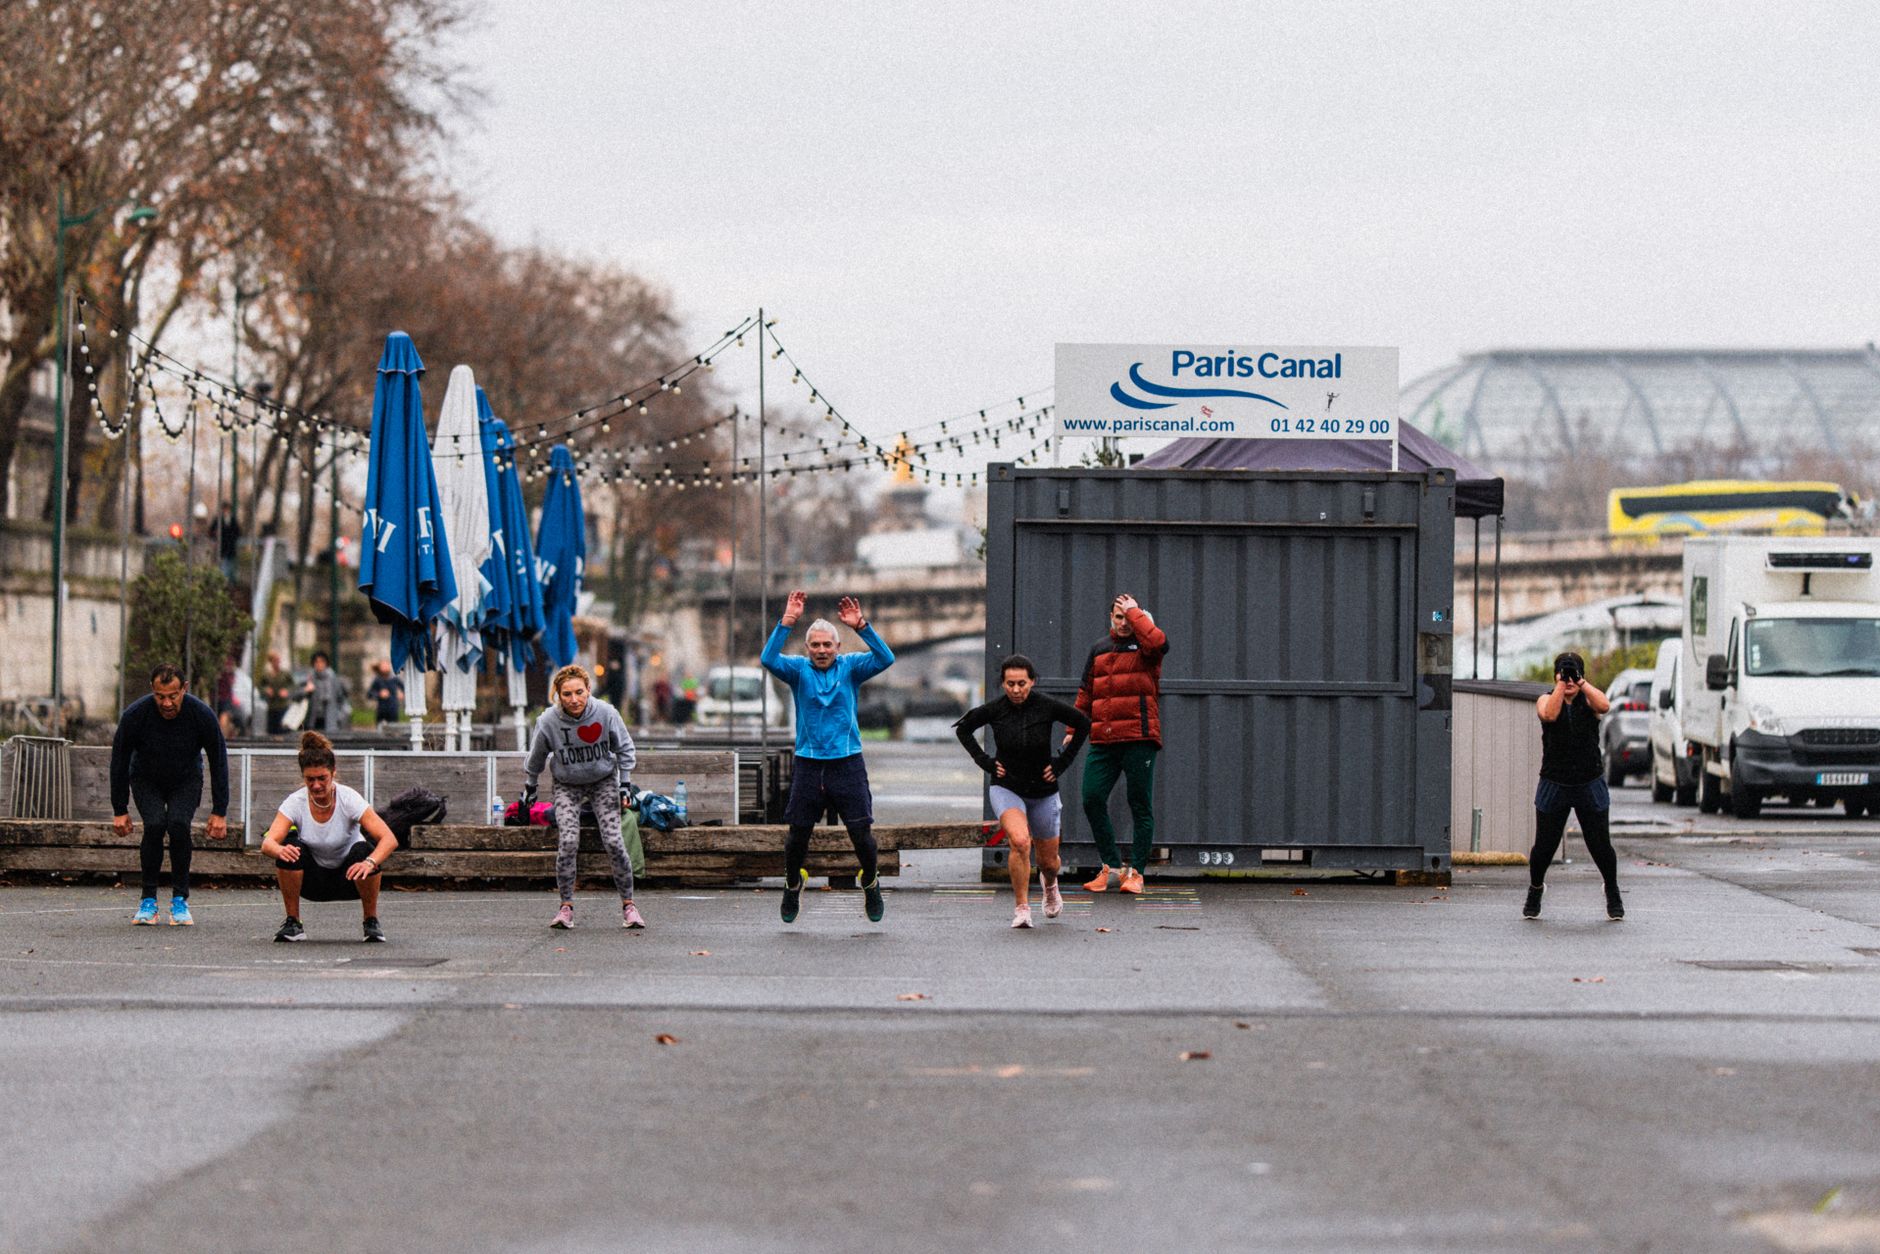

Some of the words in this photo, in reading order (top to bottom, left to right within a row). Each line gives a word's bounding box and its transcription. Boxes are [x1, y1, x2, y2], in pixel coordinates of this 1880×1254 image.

[1064, 416, 1235, 434] www.pariscanal.com
[1271, 418, 1290, 433] 01
[1296, 418, 1315, 433] 42
[1320, 419, 1340, 433] 40
[1345, 419, 1365, 434] 29
[1370, 419, 1390, 434] 00
[560, 728, 573, 746] I
[559, 741, 611, 765] LONDON
